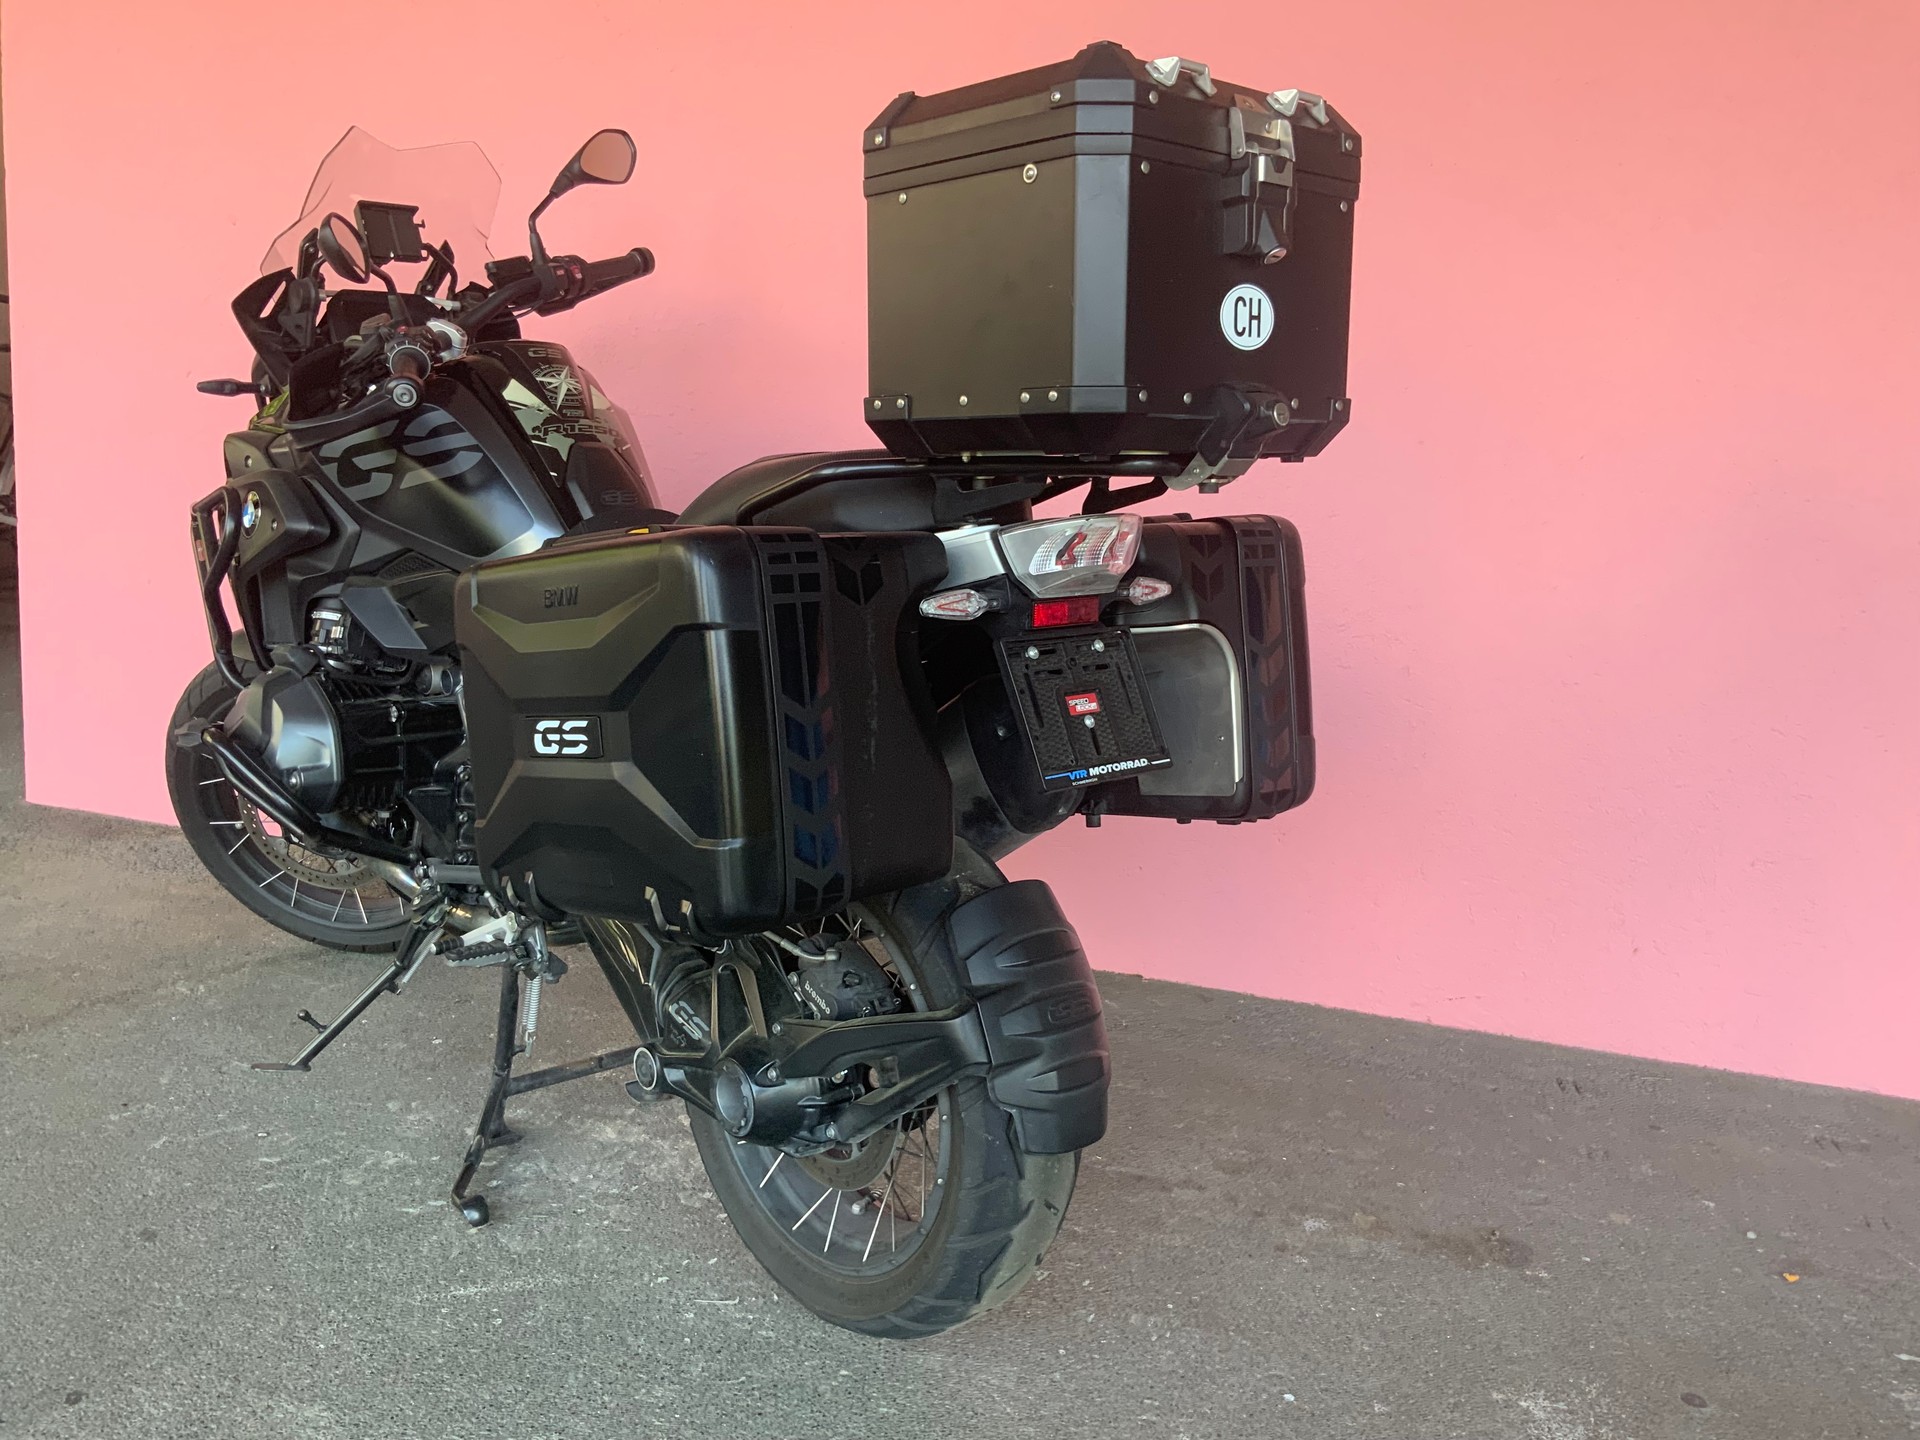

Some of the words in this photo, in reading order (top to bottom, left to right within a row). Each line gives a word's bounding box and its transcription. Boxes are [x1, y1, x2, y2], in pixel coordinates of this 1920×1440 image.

[1234, 295, 1261, 338] CH
[527, 347, 562, 358] GS
[319, 409, 484, 501] GS
[544, 585, 579, 609] BMW
[533, 720, 589, 754] GS
[1067, 769, 1088, 780] VTR
[1088, 758, 1149, 777] MOTORRAD
[804, 980, 831, 1015] brembo
[668, 1000, 710, 1041] GS
